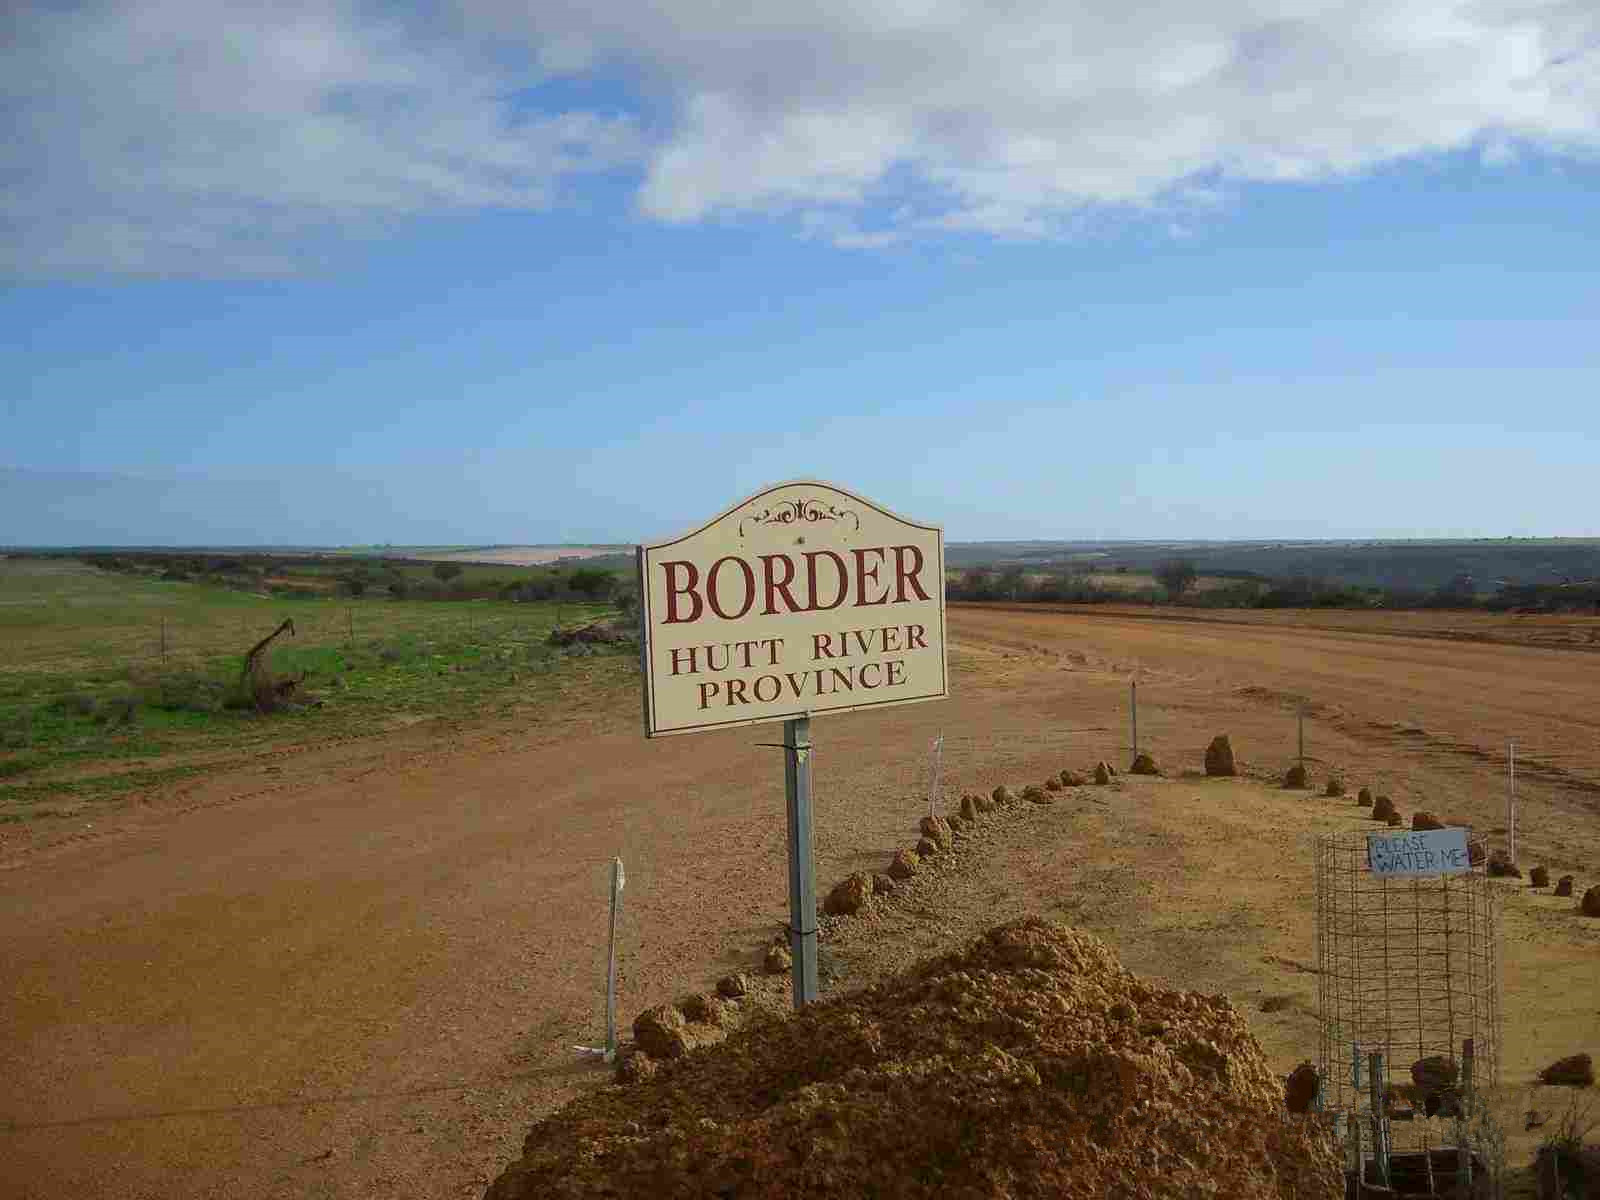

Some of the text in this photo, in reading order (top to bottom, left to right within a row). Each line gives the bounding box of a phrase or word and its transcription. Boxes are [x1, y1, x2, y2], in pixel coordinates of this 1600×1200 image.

[658, 544, 932, 625] BORDER
[669, 624, 929, 676] HUTT RIVER
[697, 660, 908, 710] PROVINCE
[1374, 834, 1427, 851] PLEASE
[1375, 848, 1467, 873] WATER ME
